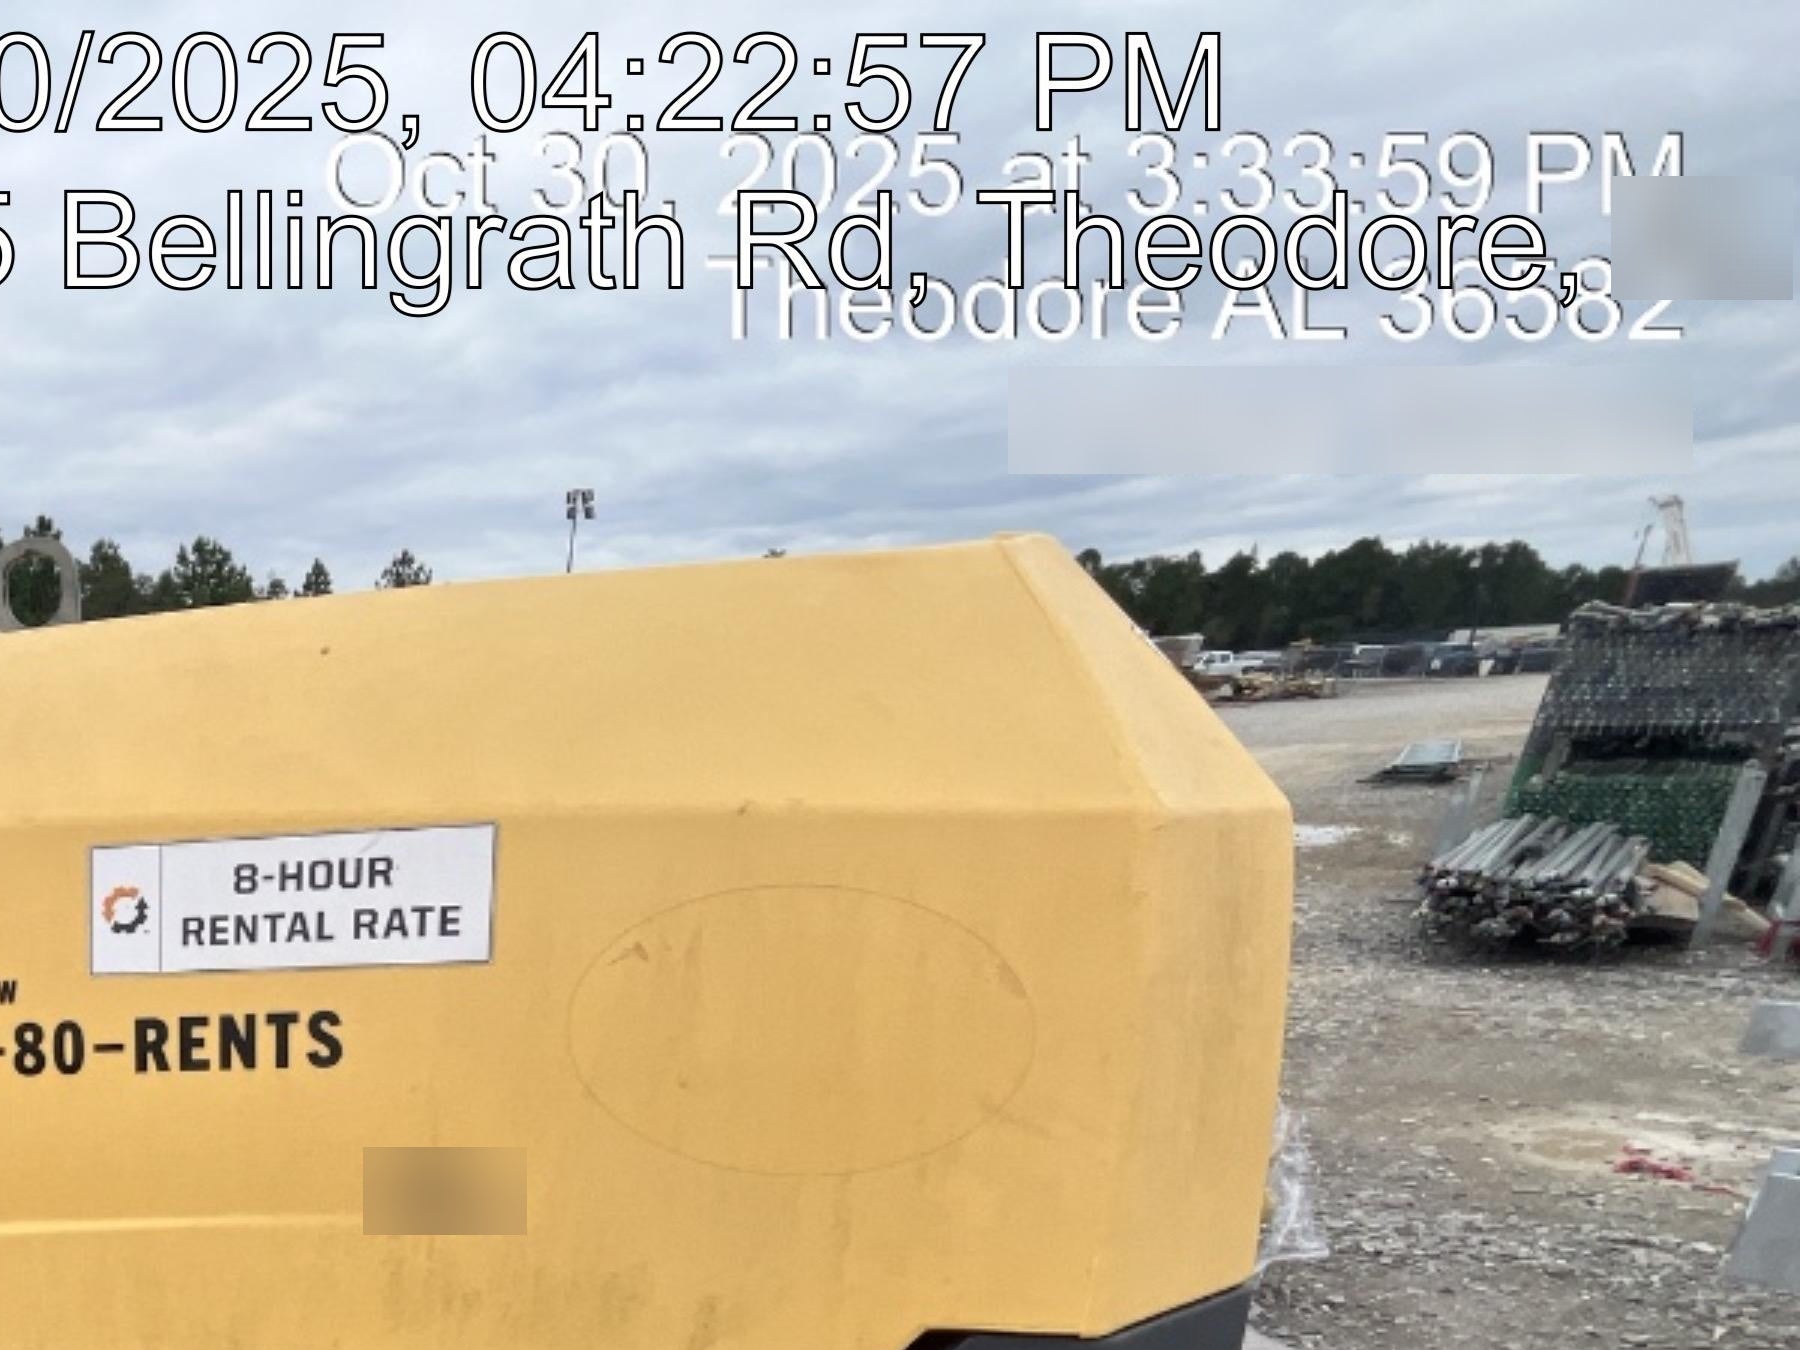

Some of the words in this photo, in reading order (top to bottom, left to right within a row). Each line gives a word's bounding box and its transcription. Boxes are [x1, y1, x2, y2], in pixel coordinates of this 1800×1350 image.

[233, 855, 395, 896] 8-HOUR
[181, 908, 335, 948] RENTAL
[351, 904, 463, 941] RATE
